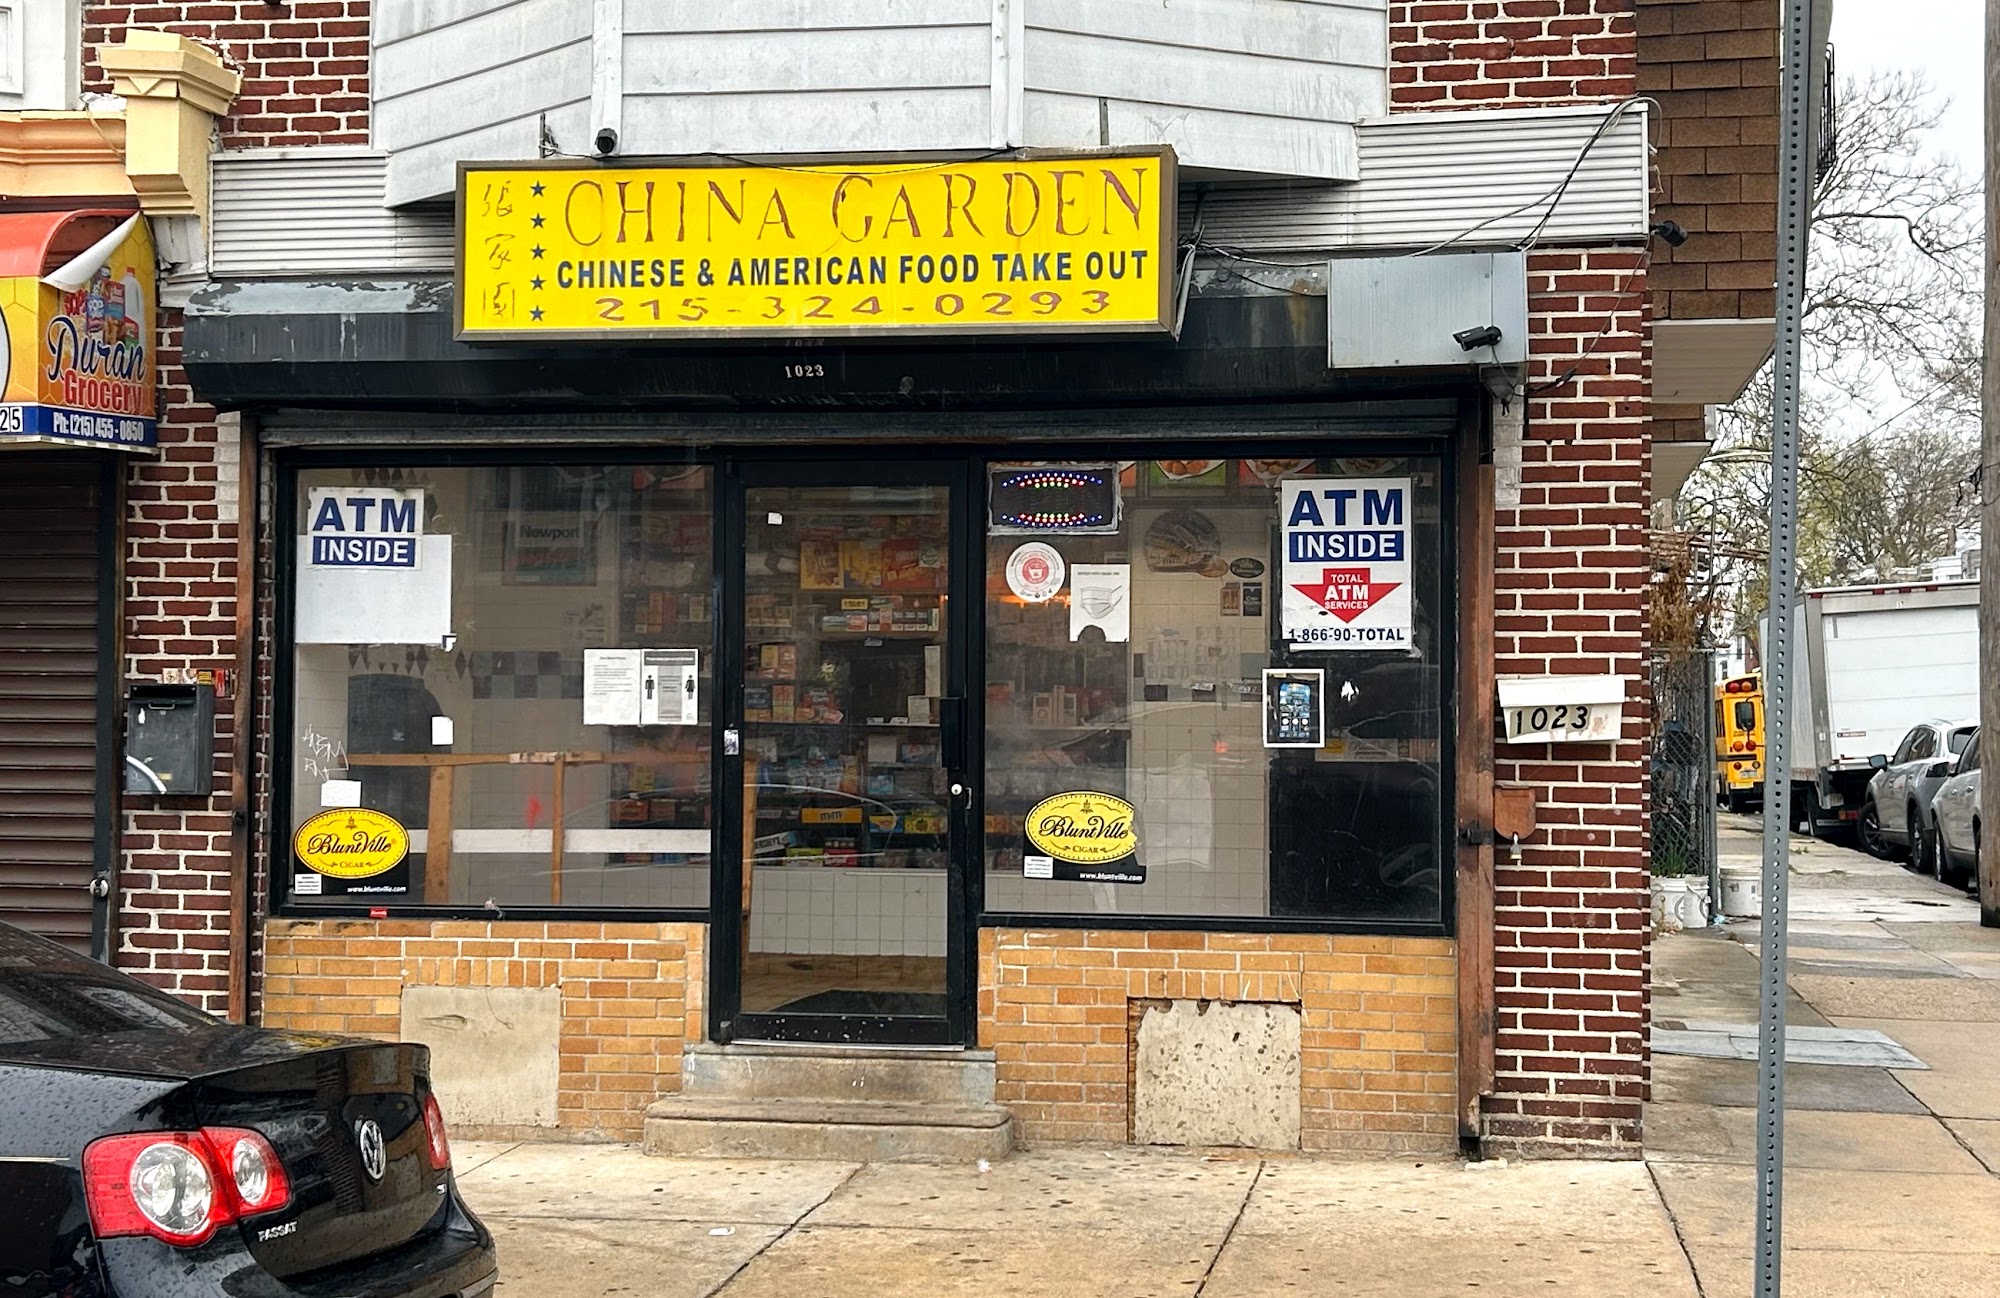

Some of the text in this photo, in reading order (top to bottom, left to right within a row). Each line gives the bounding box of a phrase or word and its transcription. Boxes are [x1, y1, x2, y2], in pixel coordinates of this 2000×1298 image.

[565, 168, 1148, 247] CHINA GARDEN
[558, 250, 1148, 289] CHINESE & AMERICAN FOOD TAKE OUT
[595, 289, 1111, 322] 215-324-0293
[48, 315, 146, 382] Duran
[785, 364, 824, 378] 1023
[63, 369, 145, 415] Grocery
[70, 414, 95, 437] (215)
[313, 498, 416, 533] ATM
[1288, 489, 1403, 526] ATM
[520, 525, 580, 541] Newport
[320, 539, 409, 563] INSIDE
[1297, 533, 1397, 560] INSIDE
[1330, 574, 1363, 584] TOTAL
[1325, 584, 1369, 601] ATM
[1325, 600, 1369, 610] SERVICES
[1288, 628, 1405, 641] 1-866-90-TOTAL
[1516, 705, 1588, 735] 1023
[1039, 816, 1129, 840] BluntVille
[307, 830, 392, 855] BluntVille
[1073, 845, 1099, 853] CIGAR
[258, 1221, 297, 1242] PASSAT
